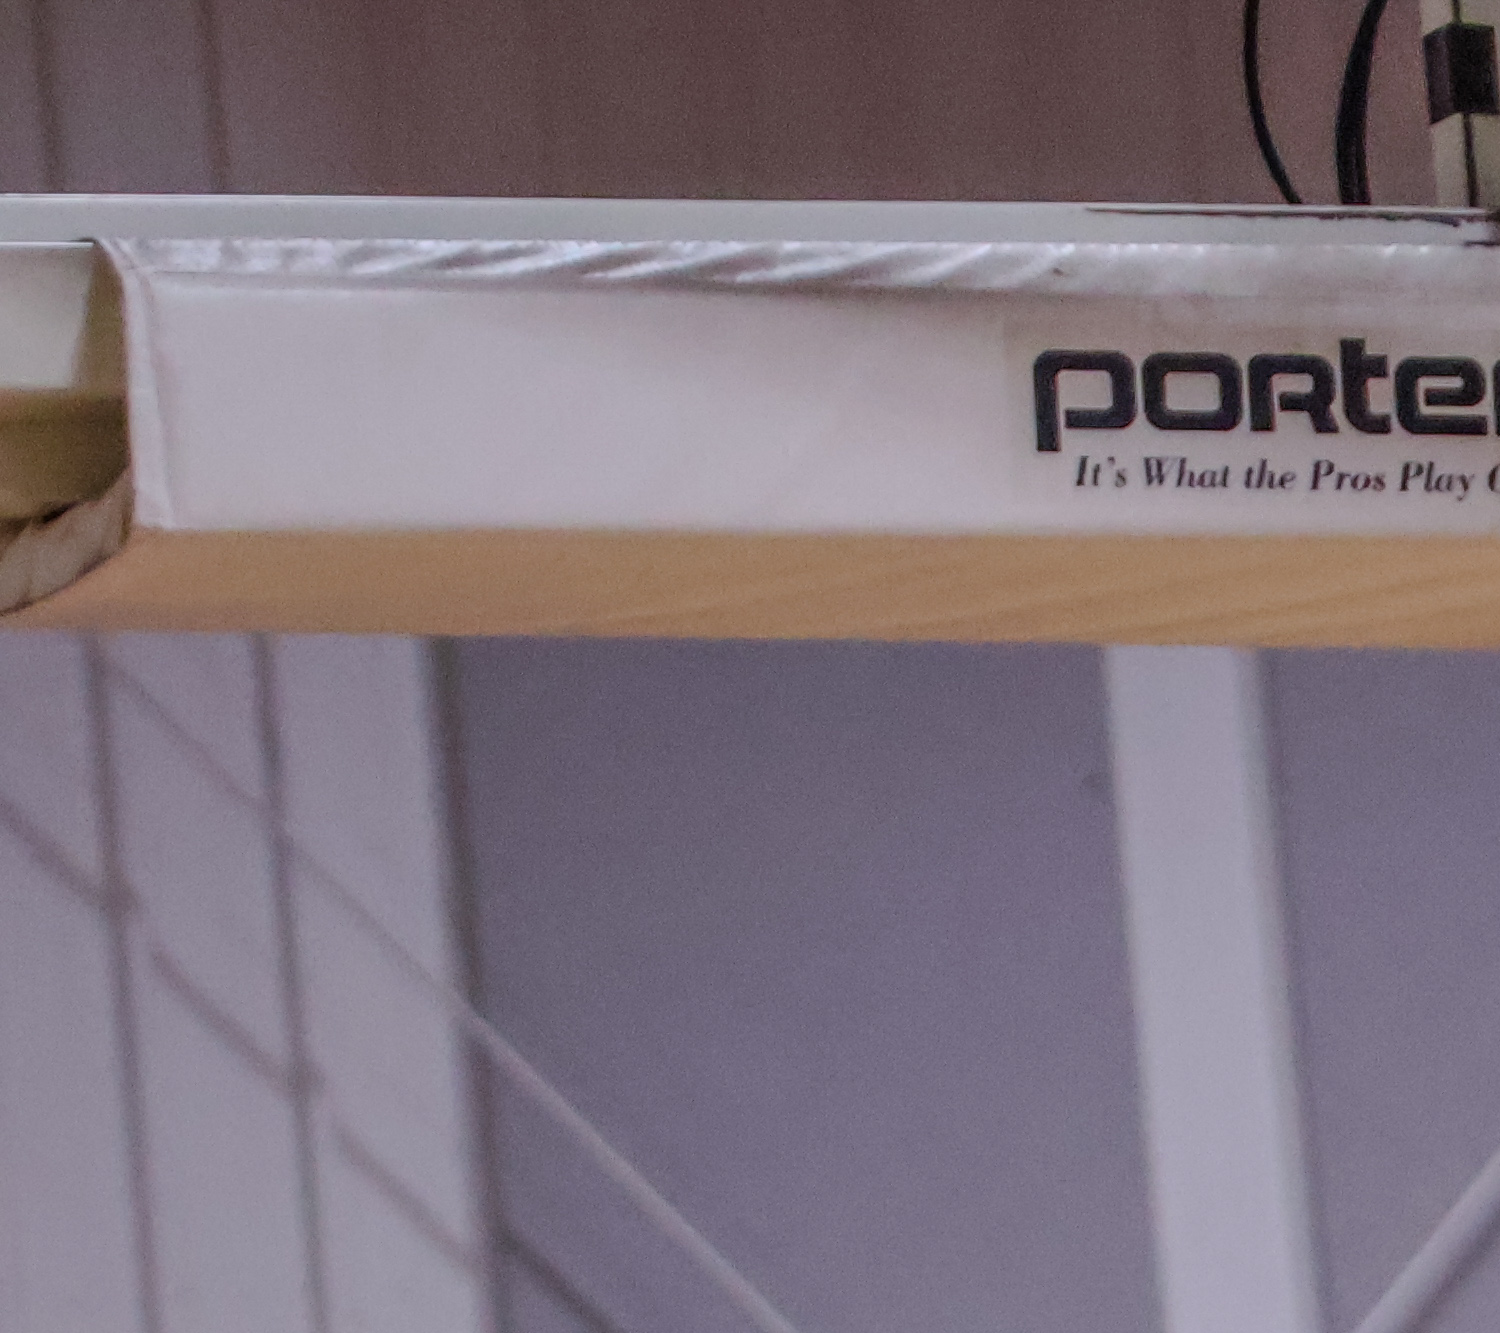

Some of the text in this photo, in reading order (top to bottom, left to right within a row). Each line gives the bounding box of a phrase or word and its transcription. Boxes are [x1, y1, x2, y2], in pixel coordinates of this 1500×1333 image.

[1075, 455, 1127, 488] It's
[1143, 456, 1229, 488] What
[1244, 457, 1297, 489] the
[1310, 459, 1387, 491] Pros
[1400, 460, 1475, 501] Play
